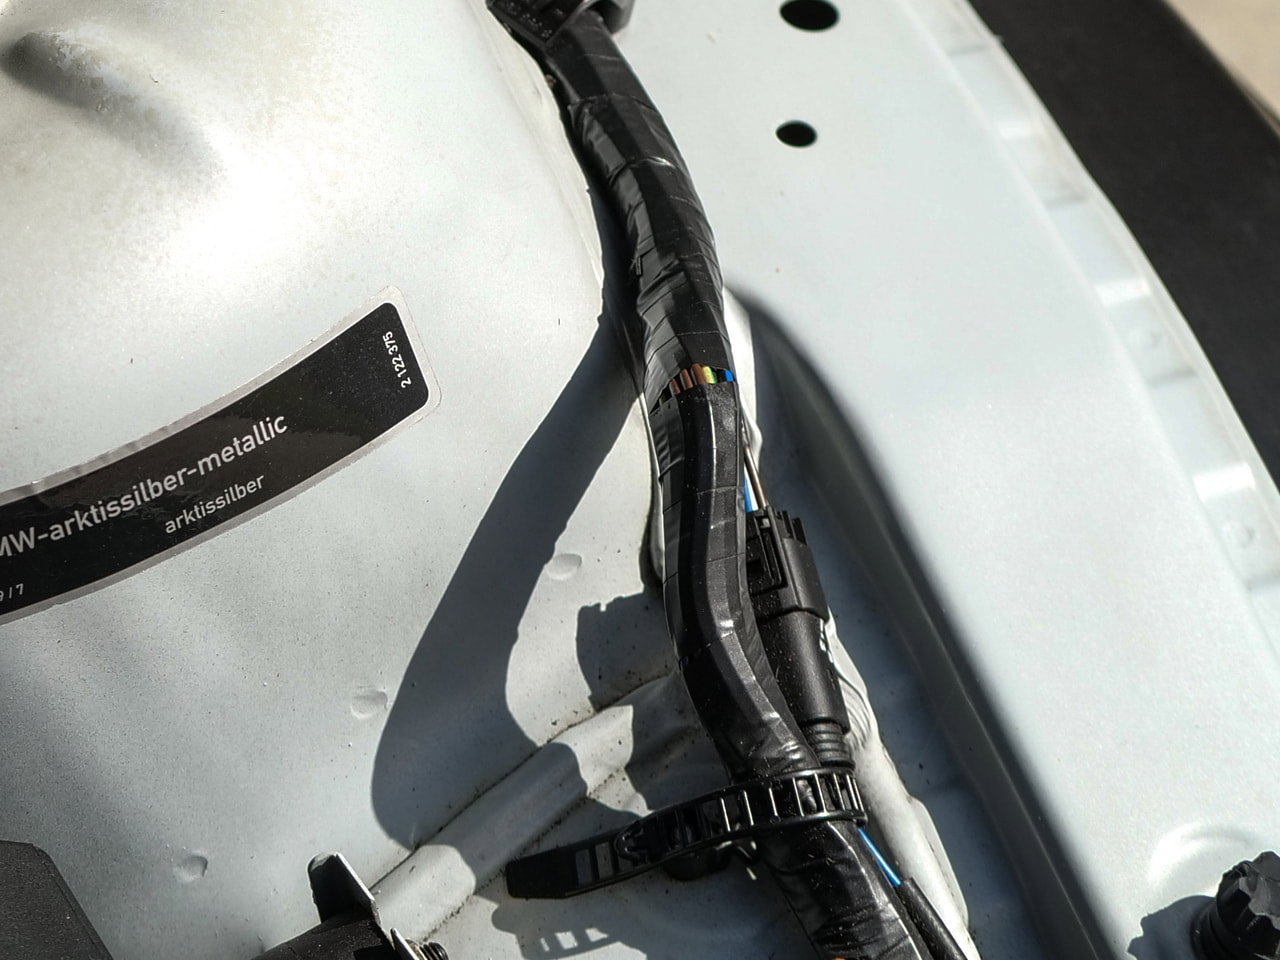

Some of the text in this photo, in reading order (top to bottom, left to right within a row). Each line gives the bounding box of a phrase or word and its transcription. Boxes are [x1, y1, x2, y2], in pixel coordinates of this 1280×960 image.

[382, 331, 412, 388] 2 122 375
[164, 474, 266, 535] arktissilber
[16, 583, 24, 596] 7
